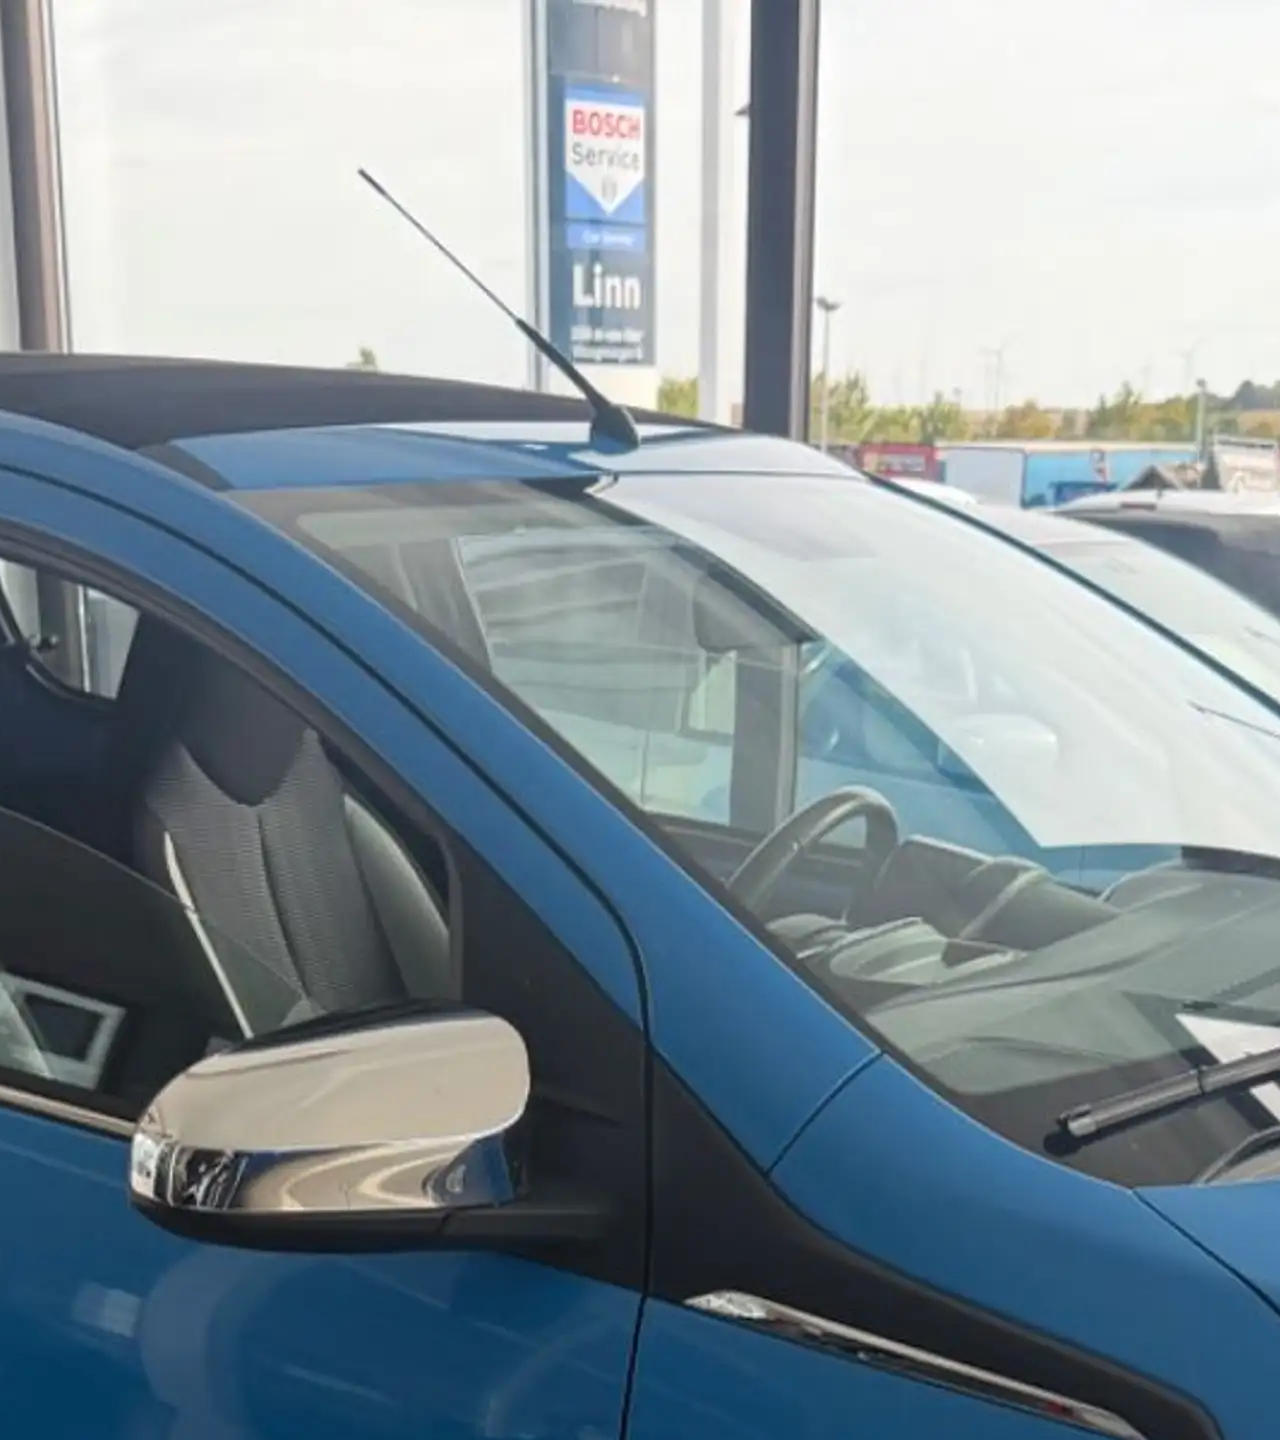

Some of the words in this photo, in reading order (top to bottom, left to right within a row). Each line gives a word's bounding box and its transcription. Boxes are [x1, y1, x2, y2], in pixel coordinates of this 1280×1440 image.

[572, 109, 640, 139] BOSCH
[572, 142, 640, 172] Service
[572, 263, 640, 309] Linn
